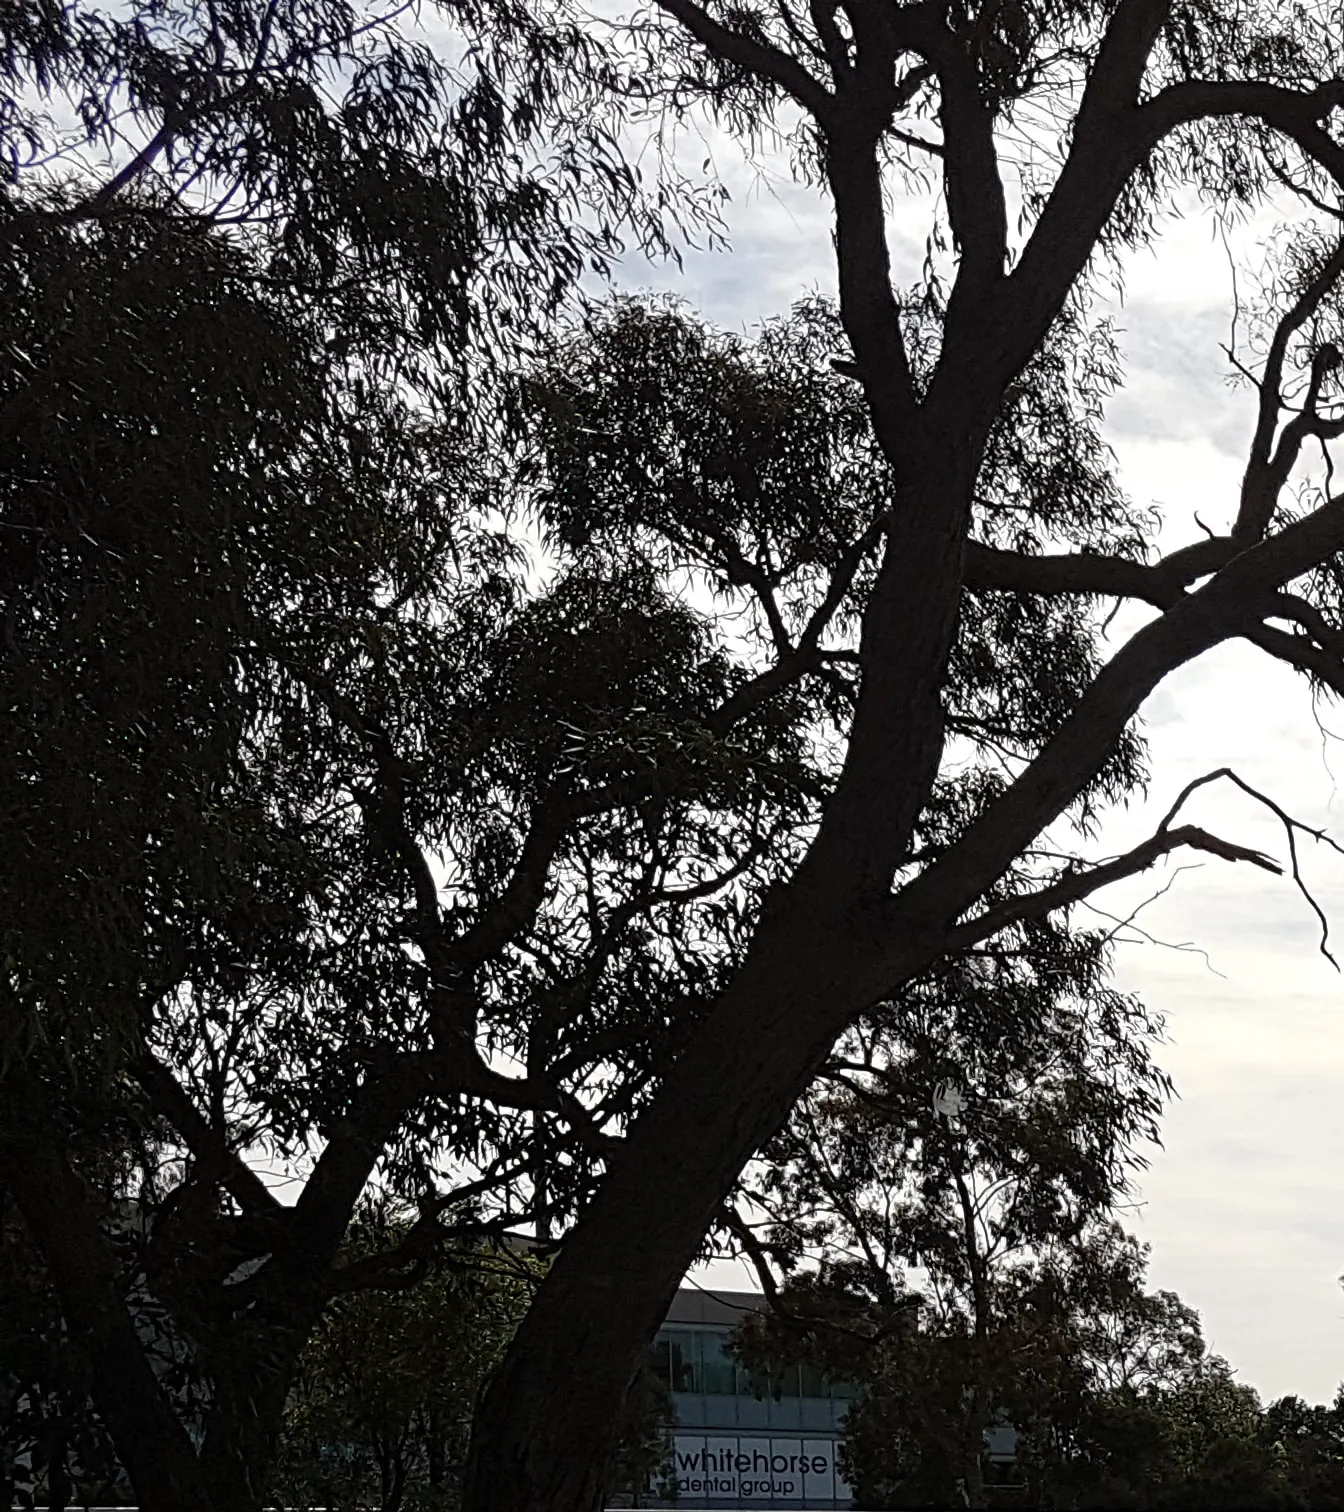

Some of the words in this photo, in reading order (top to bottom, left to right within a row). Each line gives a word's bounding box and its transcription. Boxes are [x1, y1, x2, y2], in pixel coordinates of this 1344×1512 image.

[677, 1448, 828, 1474] whitehorse
[679, 1477, 735, 1493] dental
[741, 1479, 795, 1496] group
